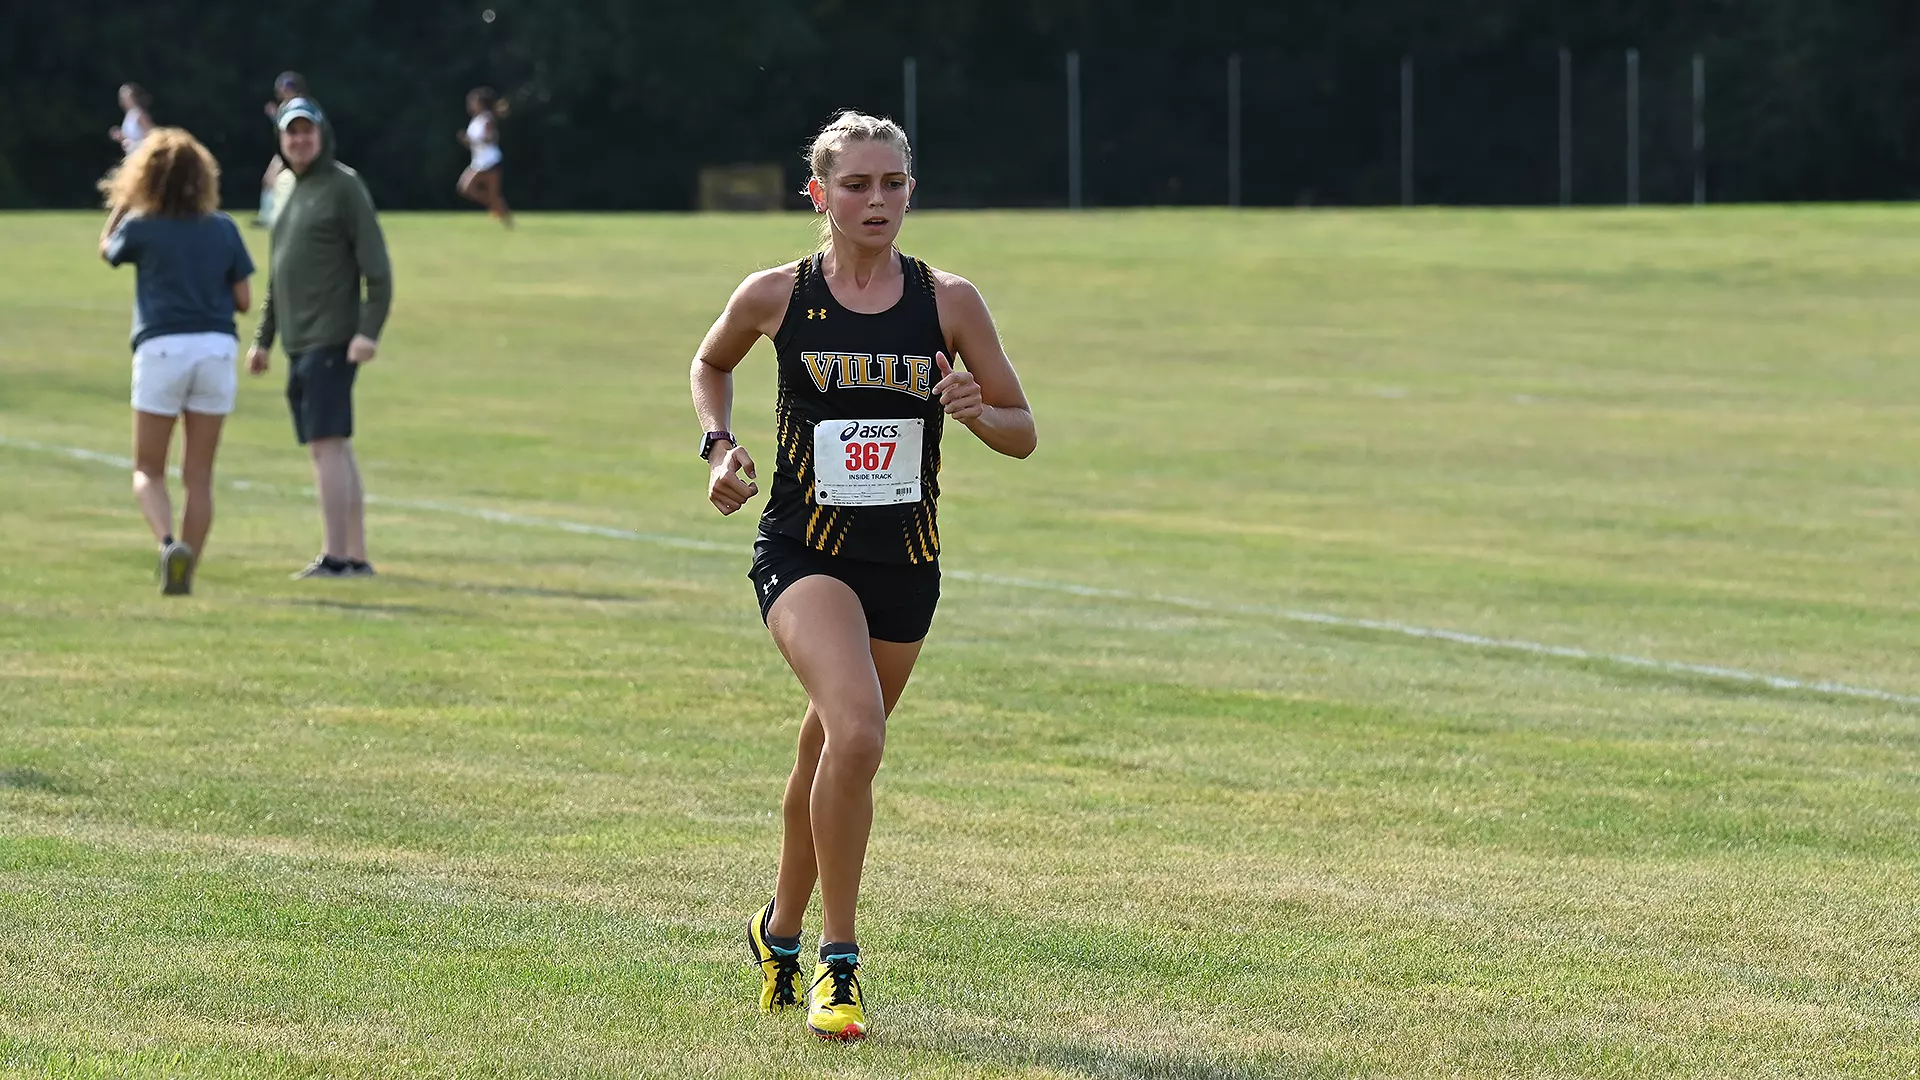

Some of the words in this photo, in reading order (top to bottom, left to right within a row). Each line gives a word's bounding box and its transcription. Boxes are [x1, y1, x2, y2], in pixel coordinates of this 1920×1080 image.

[801, 352, 931, 400] VILLE
[859, 425, 899, 439] asics
[845, 442, 897, 471] 367
[848, 473, 870, 481] INSIDE
